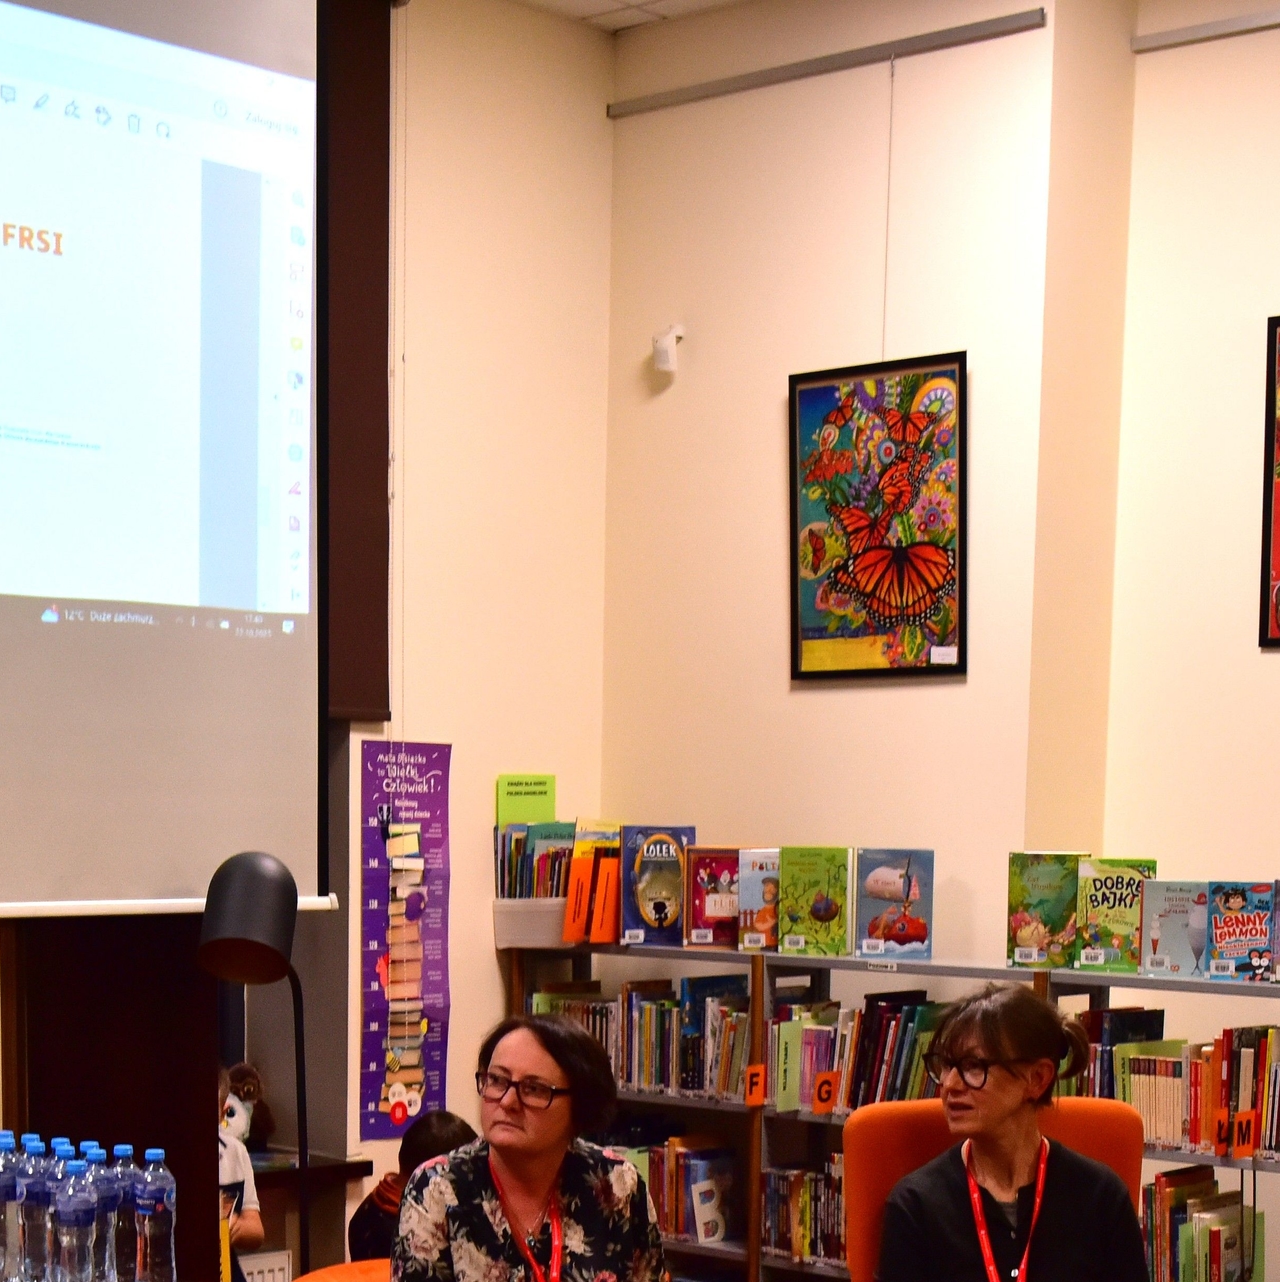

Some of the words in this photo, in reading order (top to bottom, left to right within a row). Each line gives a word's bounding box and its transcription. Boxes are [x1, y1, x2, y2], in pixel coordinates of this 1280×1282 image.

[1, 221, 66, 257] FRSI
[643, 843, 677, 858] LOLEK
[1093, 875, 1142, 896] DOBRE
[1089, 891, 1136, 910] BAJKI
[748, 1072, 760, 1096] F
[817, 1078, 833, 1103] G
[1237, 1119, 1252, 1147] M
[690, 1179, 727, 1244] B
